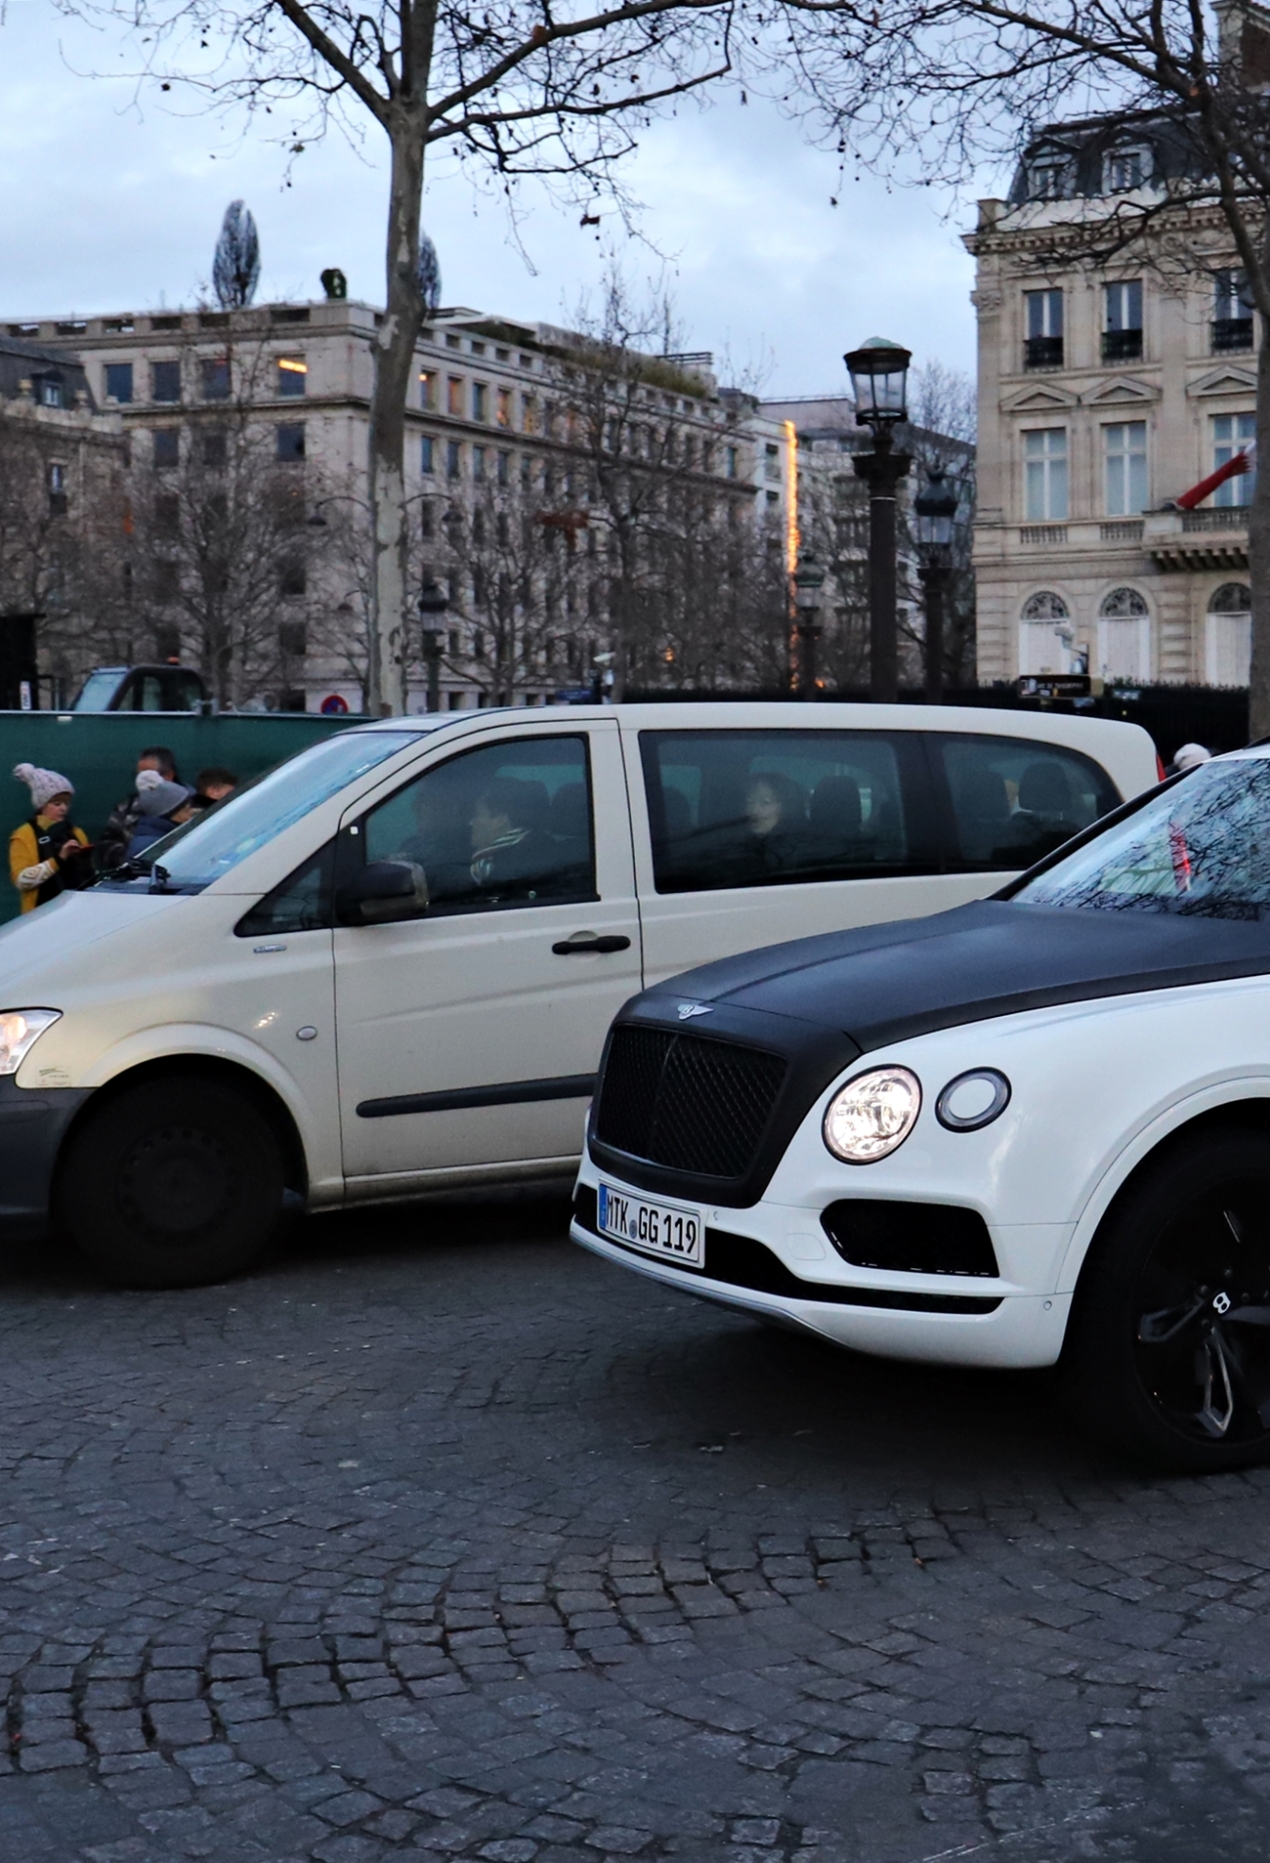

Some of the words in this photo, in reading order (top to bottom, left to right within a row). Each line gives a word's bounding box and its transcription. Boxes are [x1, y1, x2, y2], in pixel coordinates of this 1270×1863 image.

[606, 1193, 629, 1235] MTK
[638, 1206, 659, 1244] GG
[662, 1213, 697, 1254] 119
